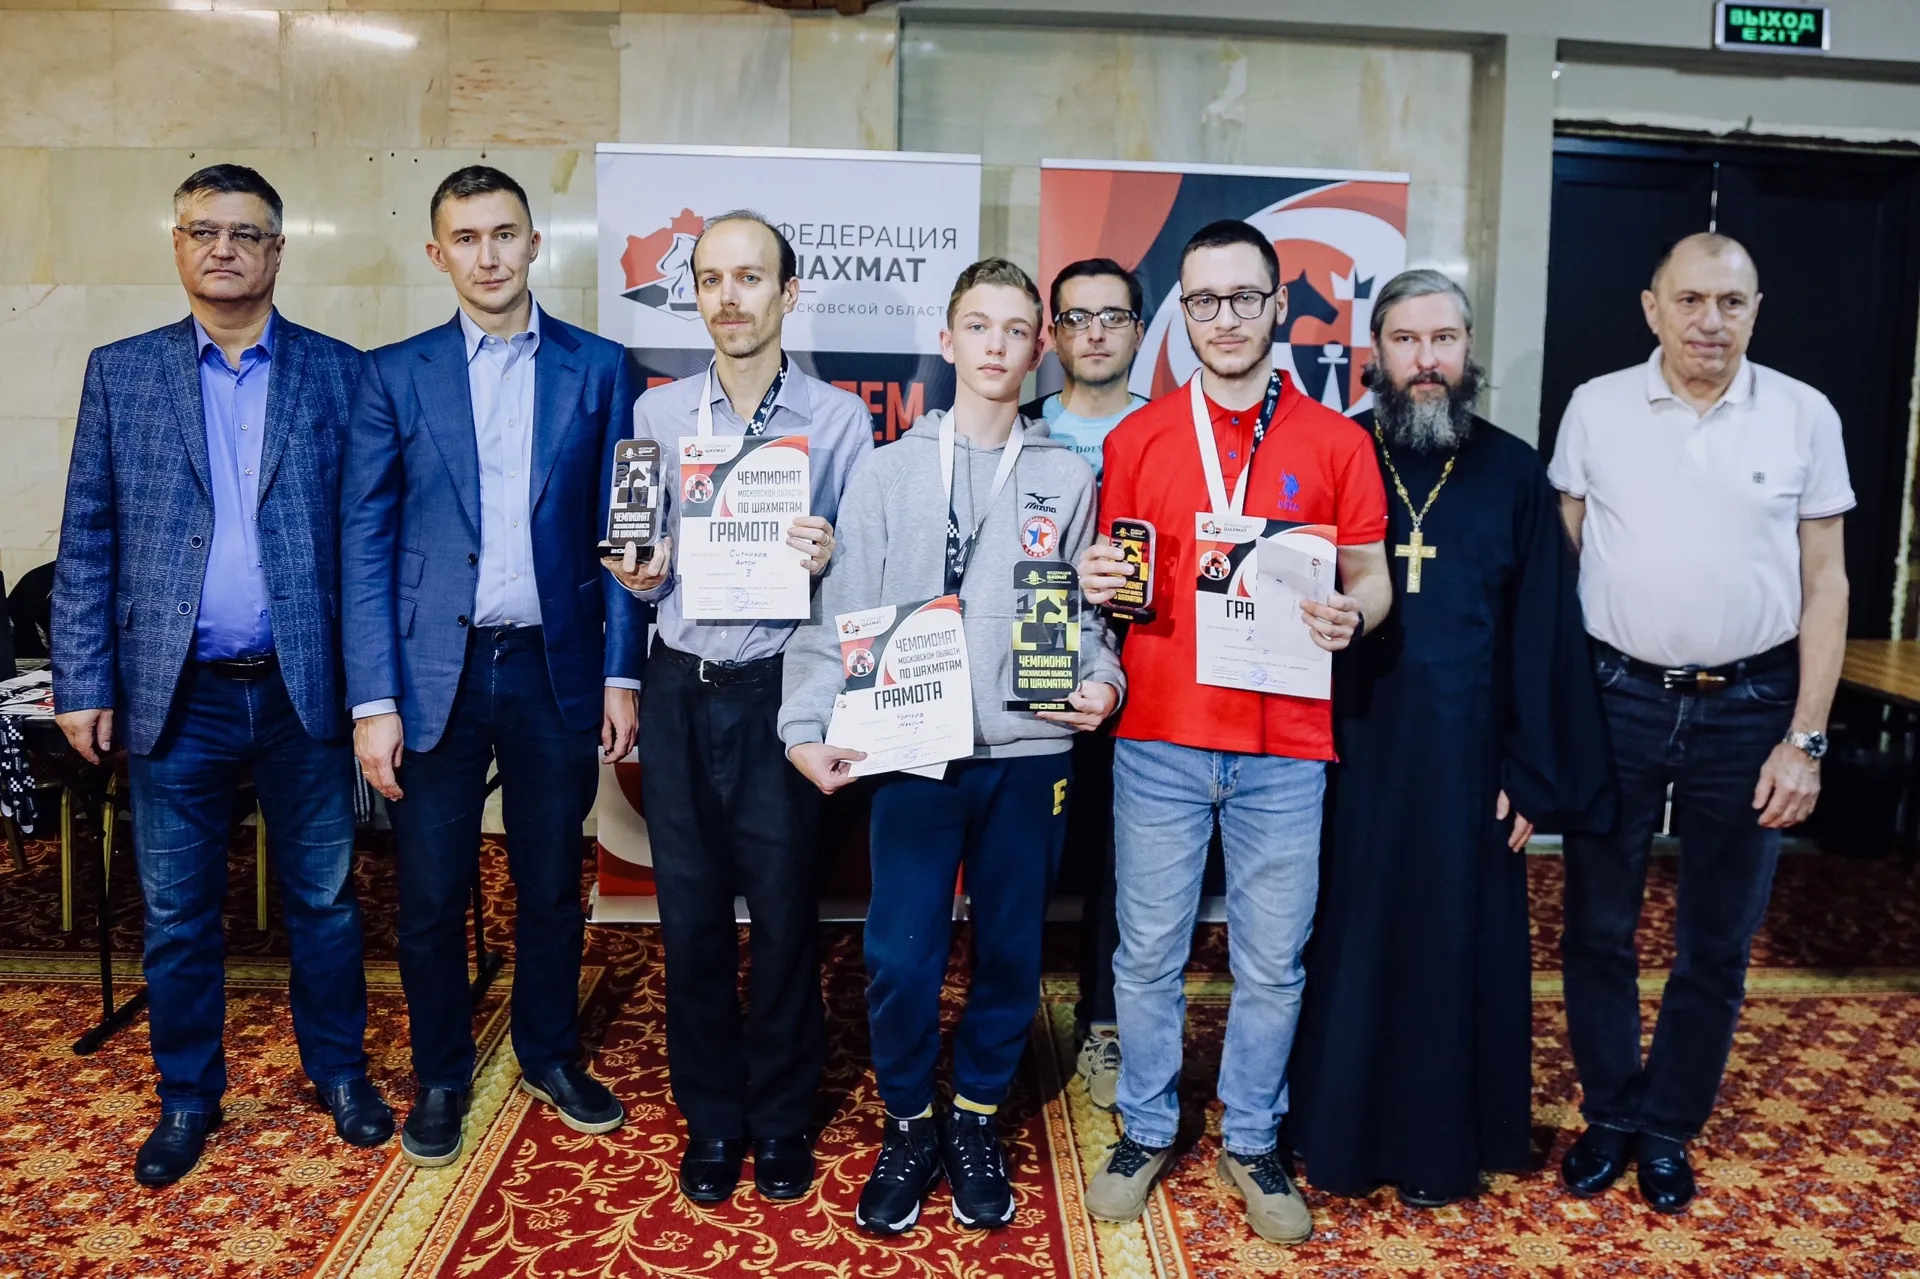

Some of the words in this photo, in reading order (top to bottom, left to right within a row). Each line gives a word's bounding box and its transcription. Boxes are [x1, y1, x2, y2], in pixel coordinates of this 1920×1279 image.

[1729, 8, 1816, 32] ВЫХОД
[1741, 27, 1801, 43] EXIT
[775, 222, 957, 251] ФЕДЕРАЦИЯ
[796, 302, 878, 315] СКОВСКОЙ
[885, 304, 945, 317] ОБЛАСТ
[737, 470, 802, 485] ЧЕМПИОНАТ
[738, 503, 748, 513] ПО
[751, 501, 803, 513] ШАХМАТАМ
[614, 512, 651, 522] ЧЕМПИОНАТ
[709, 521, 779, 542] ГРАМОТА
[1016, 594, 1033, 613] 1
[895, 629, 957, 652] ЧЕМПИОНАТ
[898, 652, 935, 665] МОСКОВСКОЙ
[935, 648, 961, 659] ОБЛАСТИ
[1018, 655, 1073, 668] ЧЕМПИОНАТ
[899, 668, 911, 680] ПО
[913, 659, 963, 677] ШАХМАТАМ
[1018, 678, 1029, 689] ПО
[1029, 678, 1073, 689] ШАХМАТАМ
[874, 681, 943, 710] ГРАМОТА
